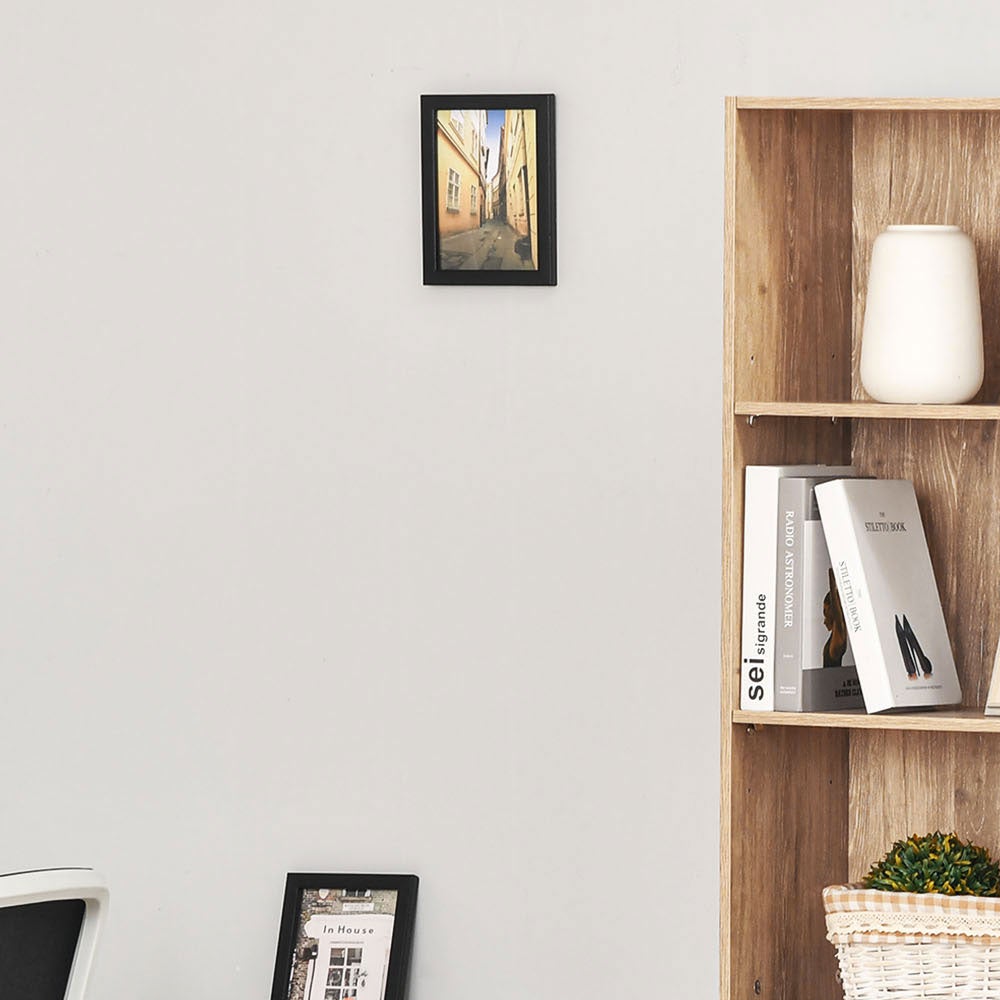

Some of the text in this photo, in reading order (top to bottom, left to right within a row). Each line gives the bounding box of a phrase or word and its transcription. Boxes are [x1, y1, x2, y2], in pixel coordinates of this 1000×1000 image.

[784, 511, 795, 629] RADIO ASTRONOMER
[743, 593, 768, 701] sei sigrande
[323, 925, 374, 935] In House
